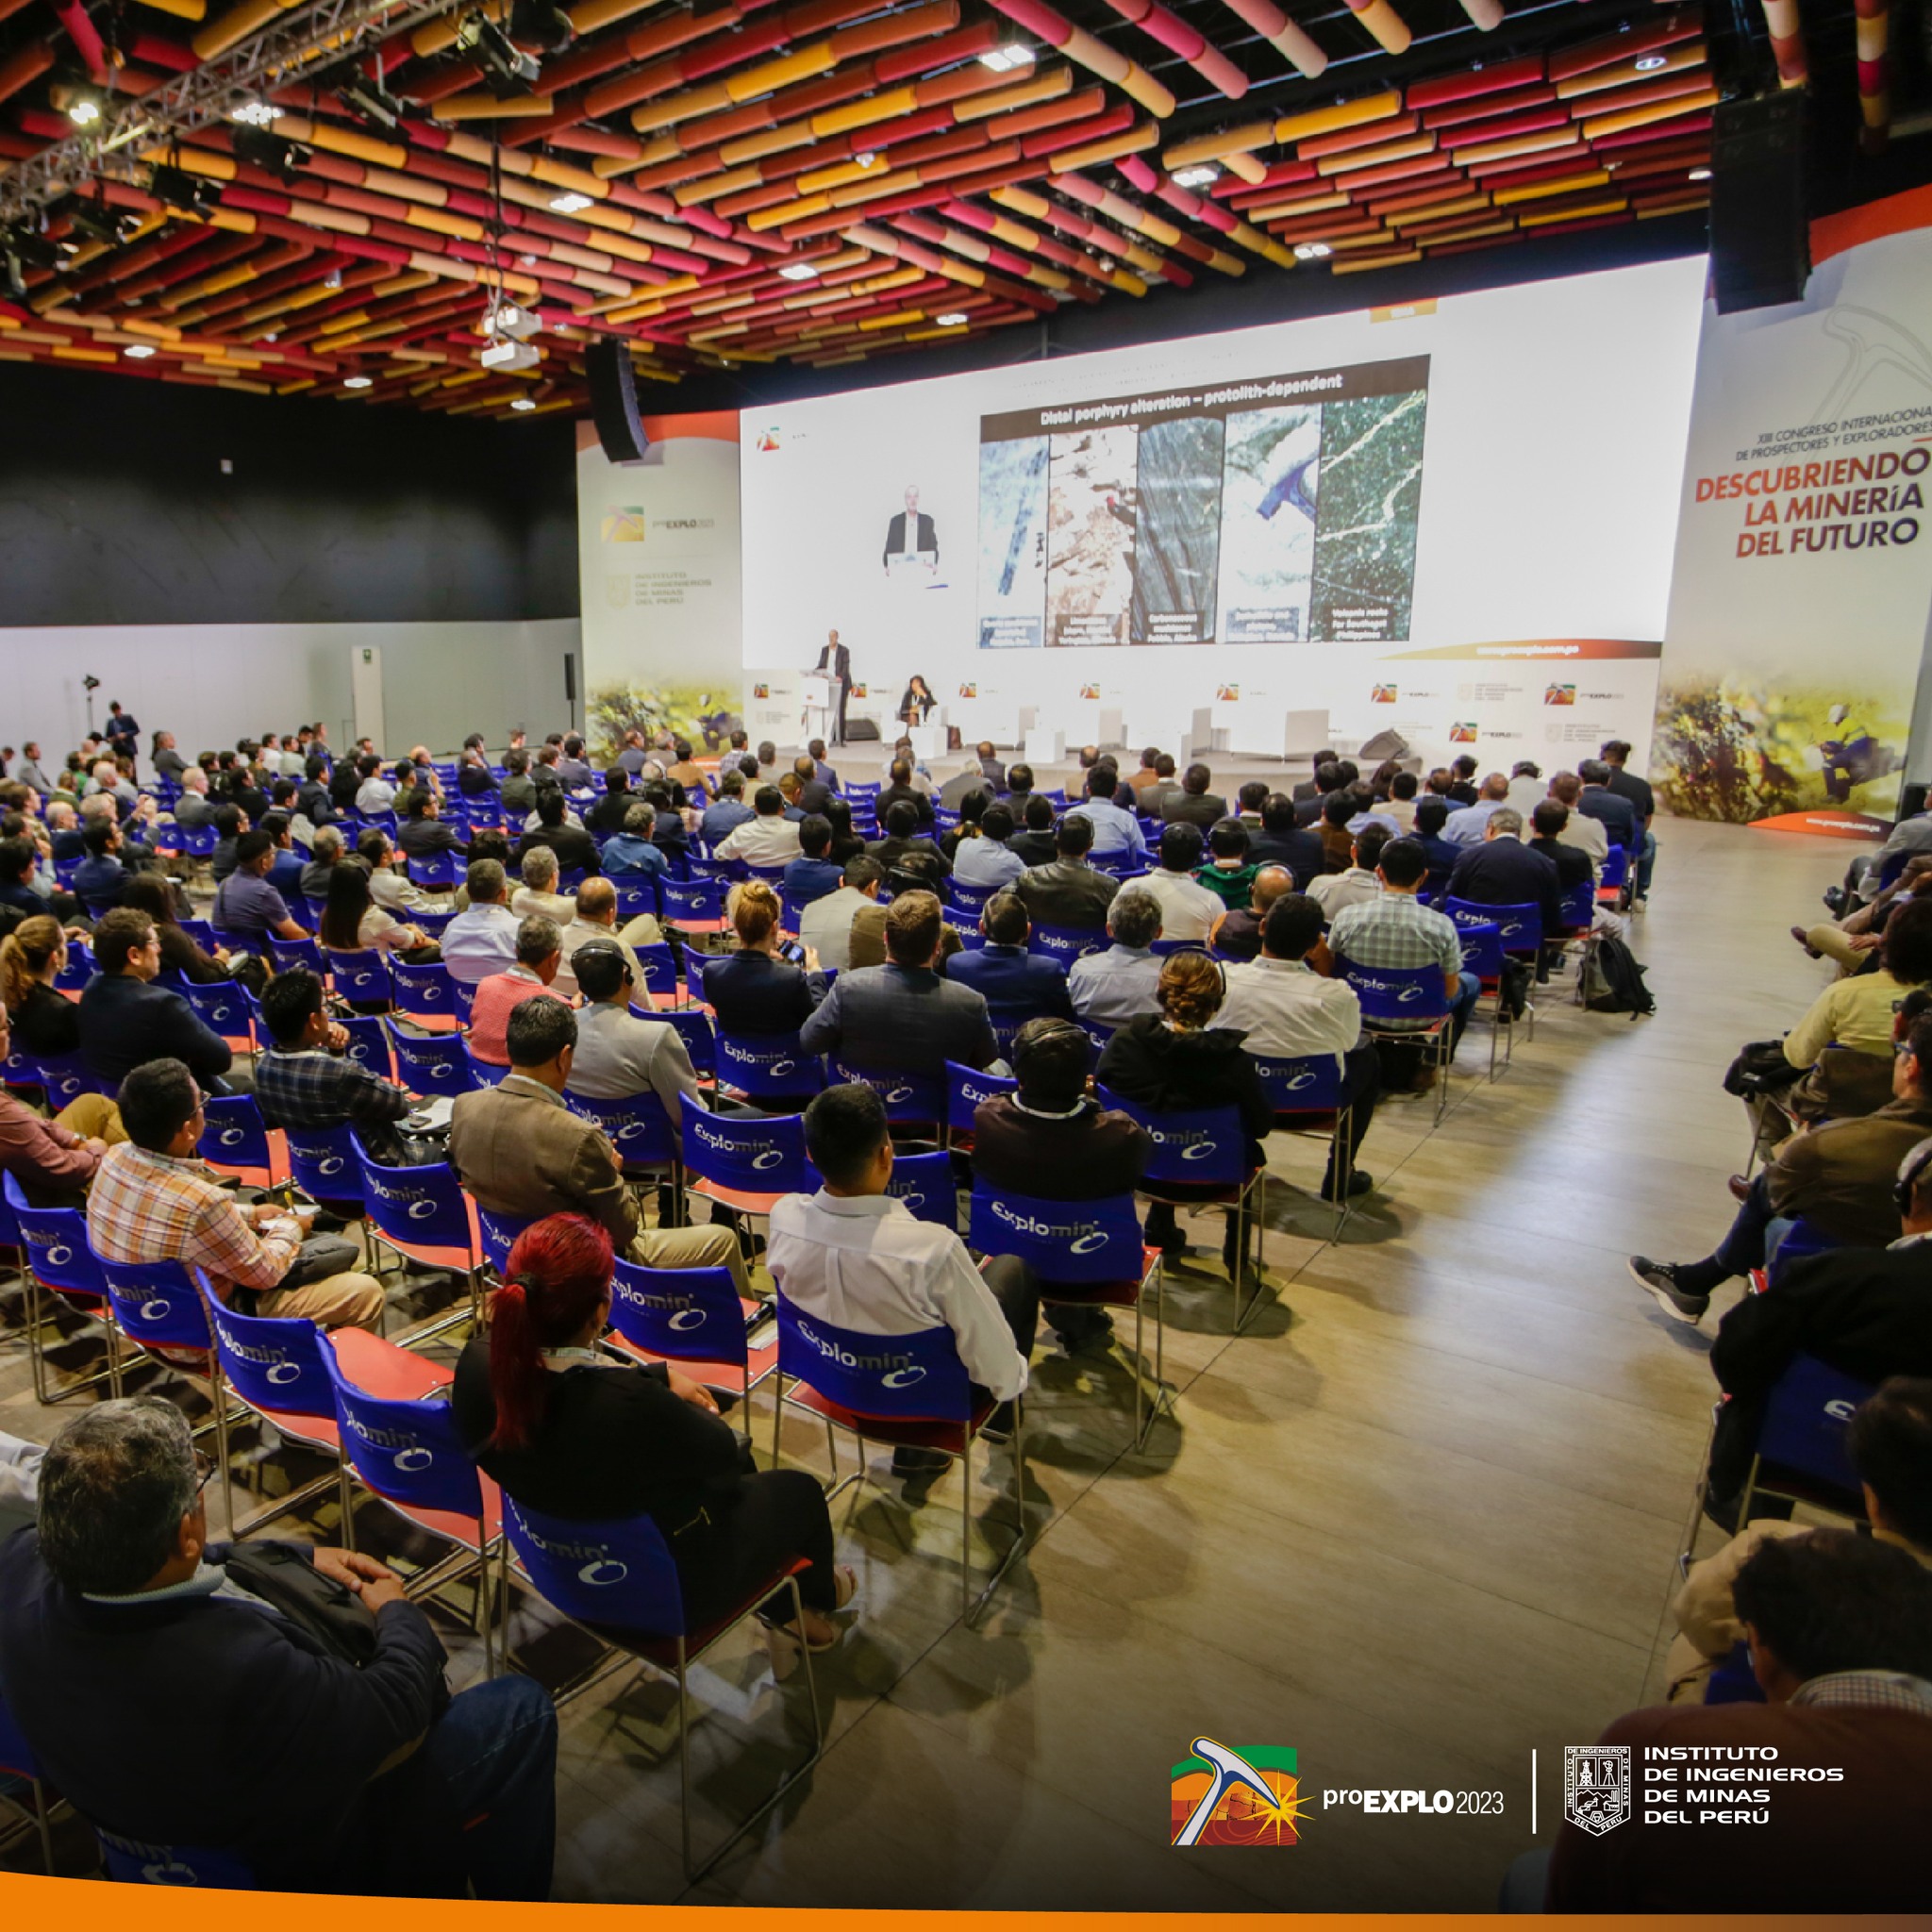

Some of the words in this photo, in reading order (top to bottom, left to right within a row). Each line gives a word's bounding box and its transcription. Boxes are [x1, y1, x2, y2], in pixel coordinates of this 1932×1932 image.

[1075, 403, 1130, 424] porphyry
[1775, 422, 1838, 443] CONGRESO
[1840, 406, 1932, 431] INTERNACIONA
[1736, 450, 1749, 461] DE
[1751, 437, 1829, 459] PROSPECTORES
[1833, 435, 1840, 446] Y
[1695, 447, 1931, 503] DESCUBRIENDO
[1744, 500, 1778, 527] LA
[1736, 530, 1785, 558] DEL
[1790, 516, 1920, 554] FUTURO
[1256, 1060, 1306, 1078] lomin
[694, 1122, 772, 1152] Explomin
[1147, 1125, 1206, 1145] lomin
[991, 1201, 1094, 1238] Explomin
[797, 1320, 909, 1371] Explomin
